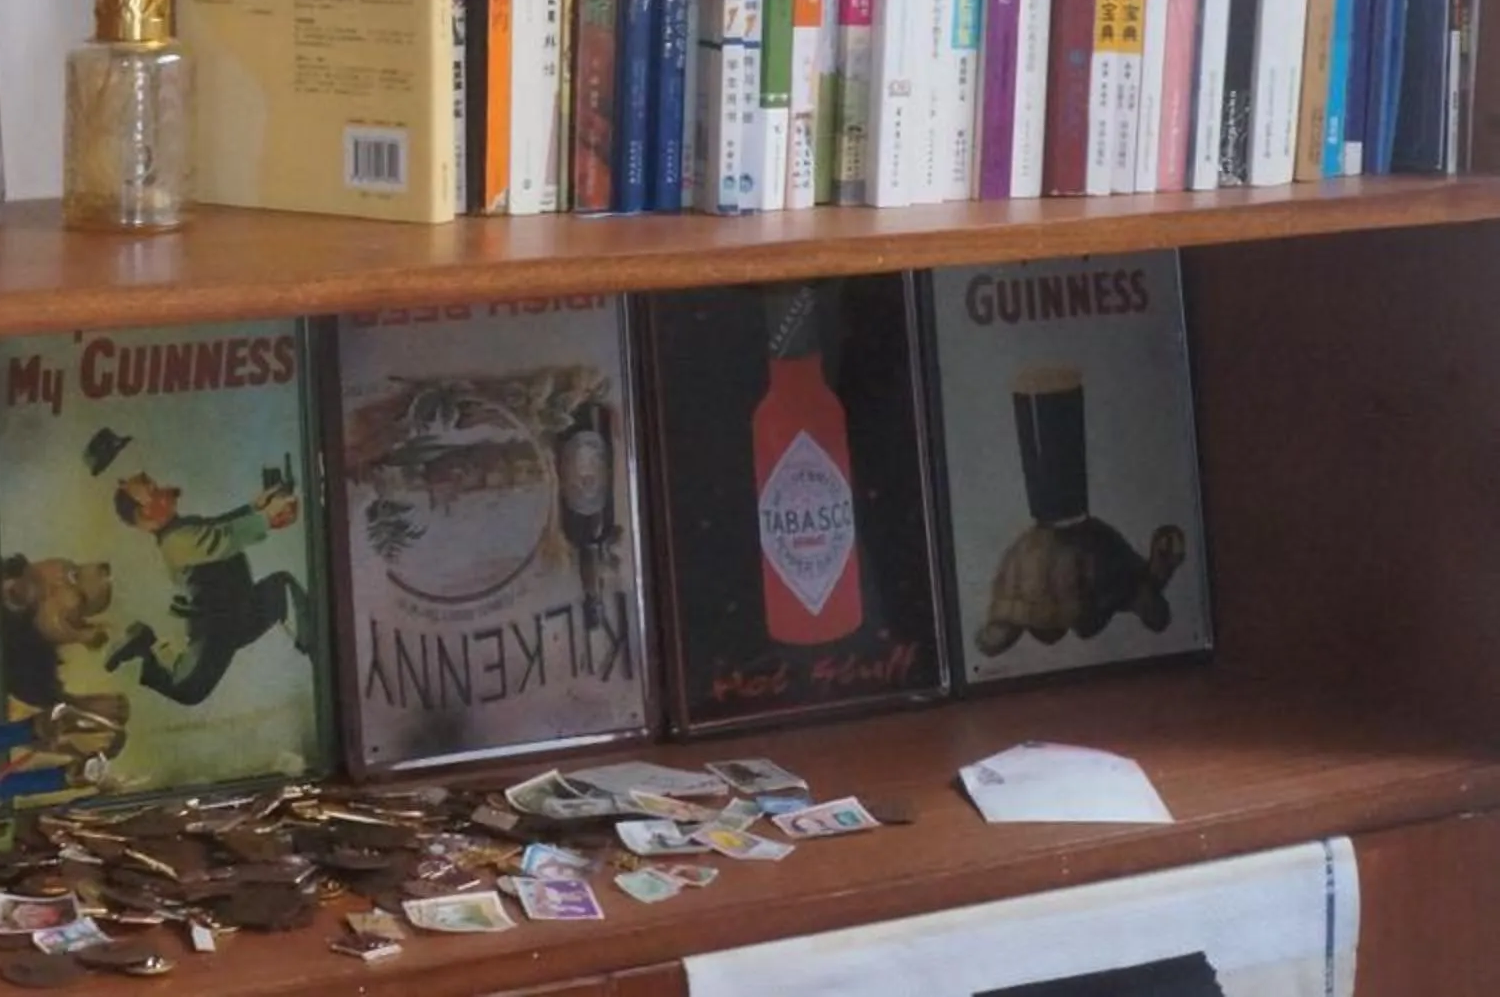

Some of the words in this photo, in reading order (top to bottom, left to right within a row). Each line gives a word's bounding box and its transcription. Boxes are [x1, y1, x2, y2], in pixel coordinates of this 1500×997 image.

[965, 269, 1150, 327] GUINNESS
[8, 354, 65, 416] My
[80, 333, 295, 400] GUINNESS
[365, 592, 635, 711] KILKENNY
